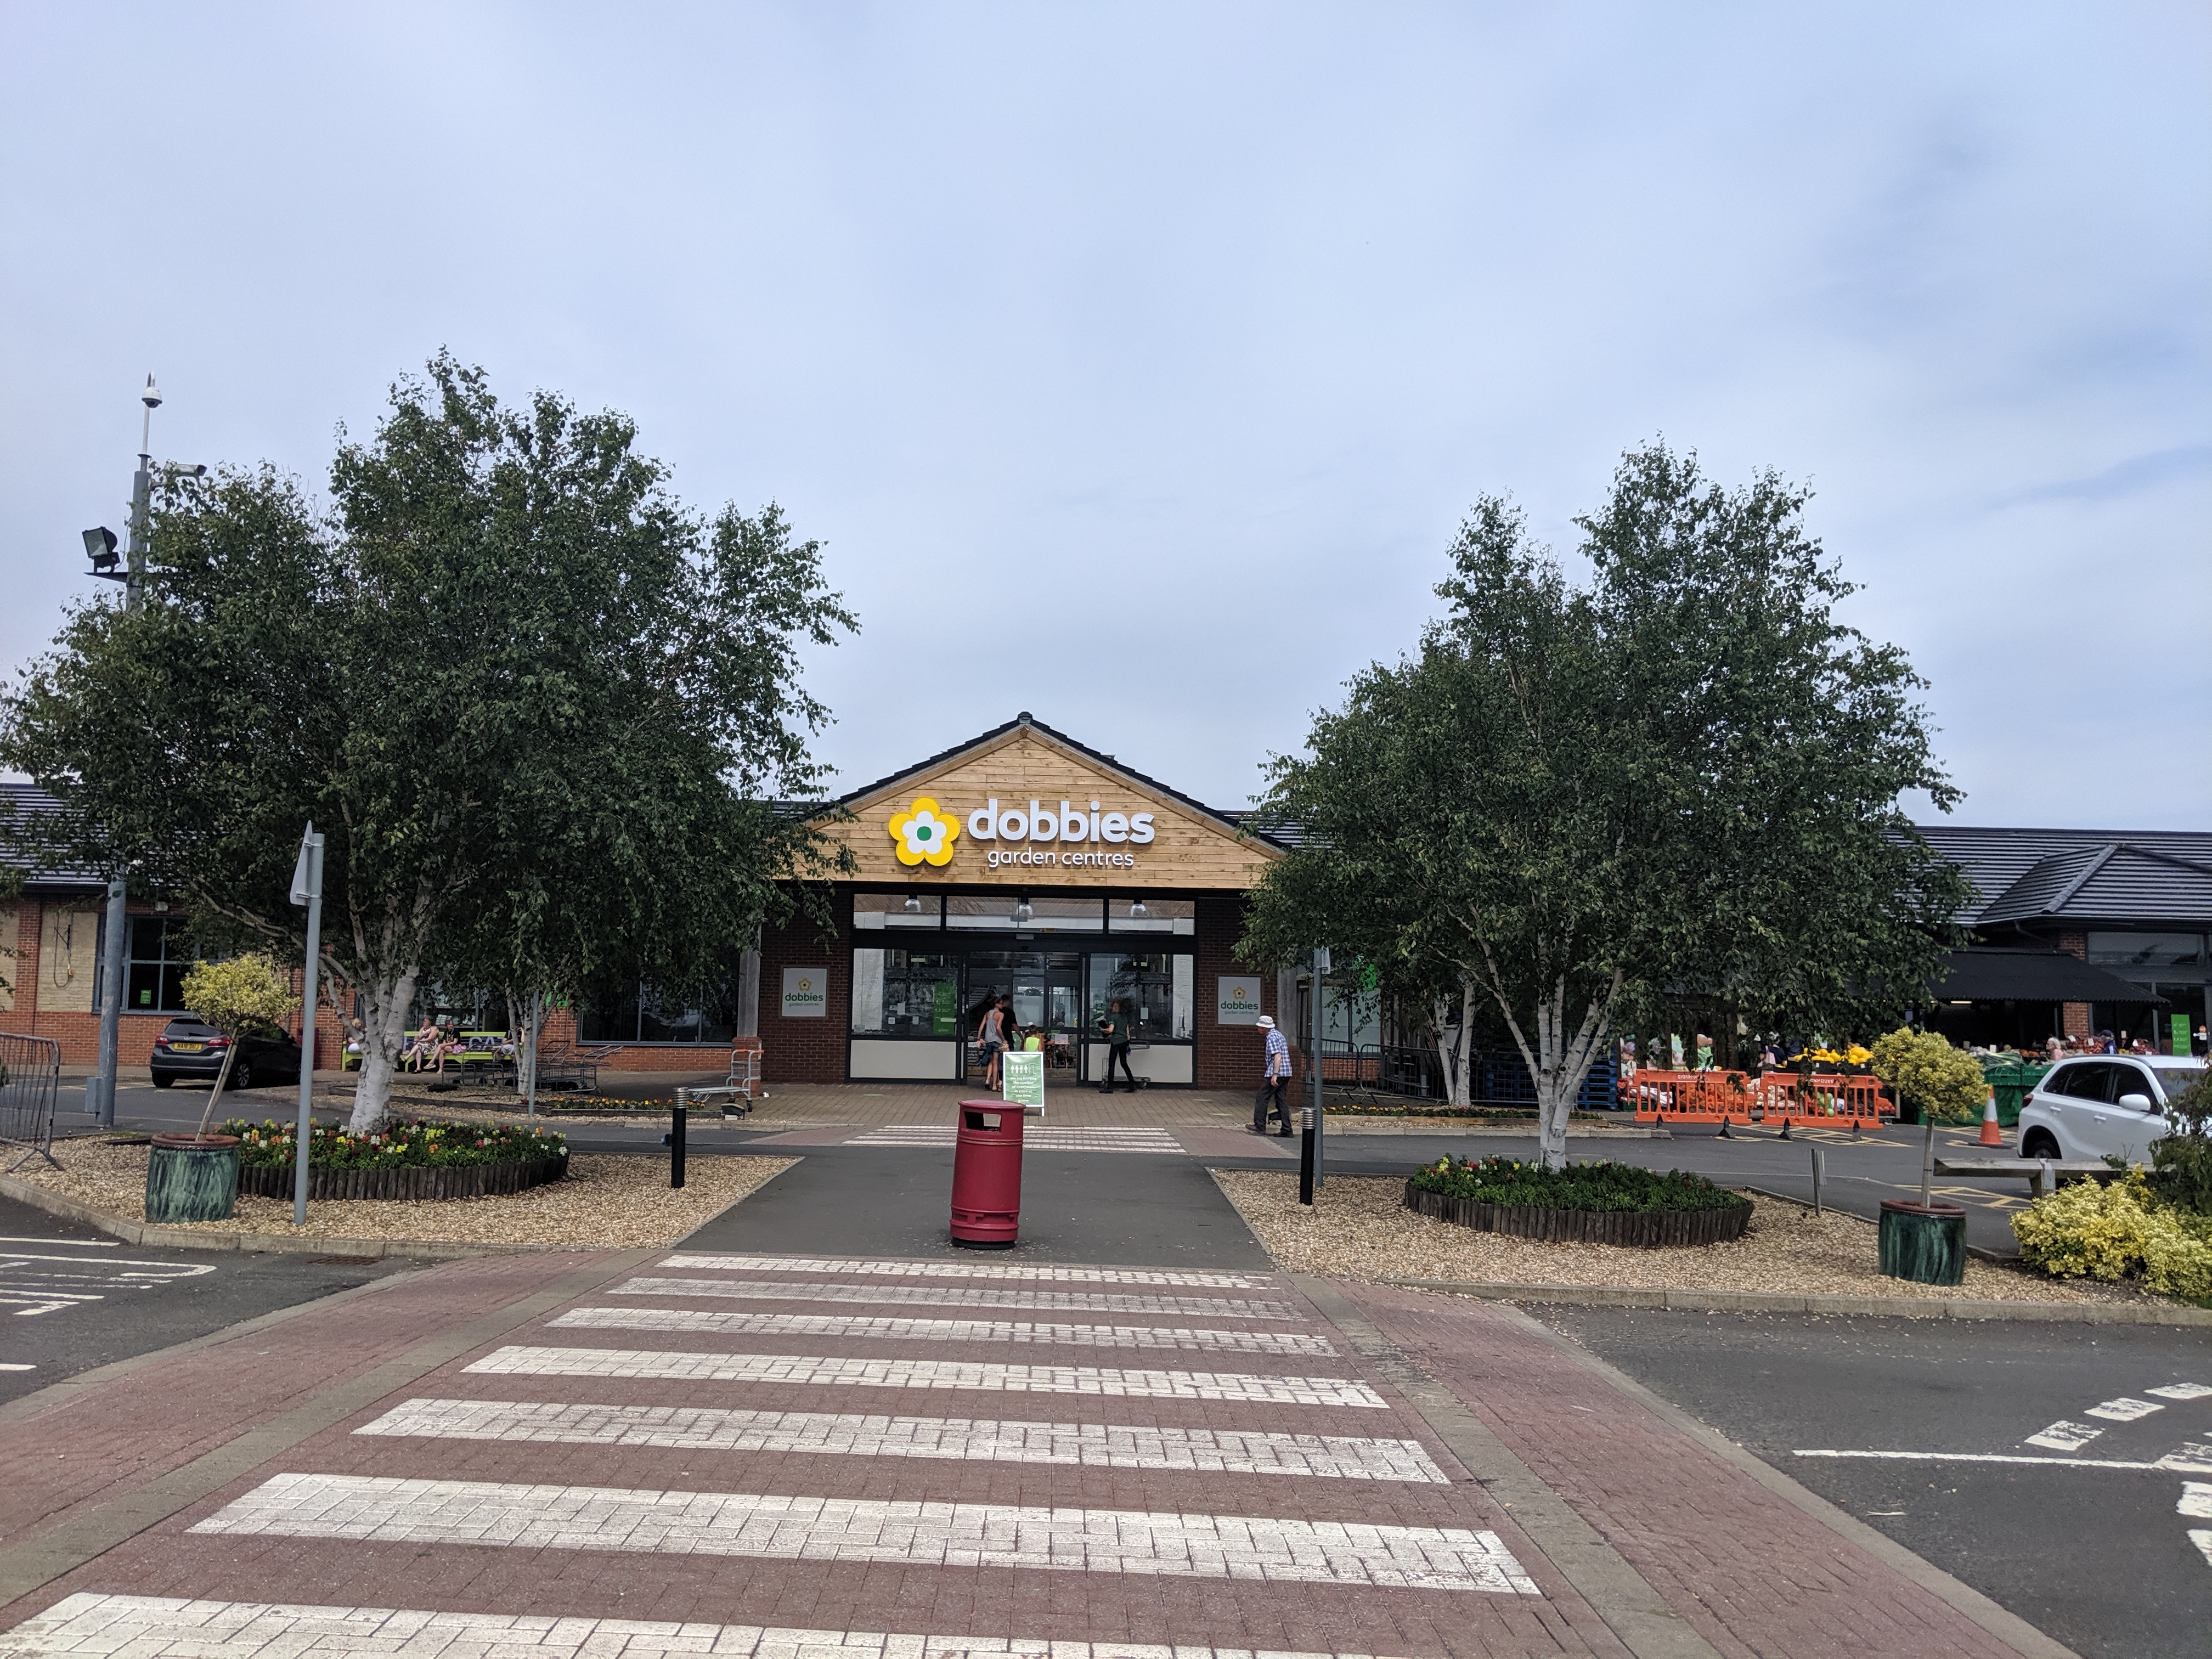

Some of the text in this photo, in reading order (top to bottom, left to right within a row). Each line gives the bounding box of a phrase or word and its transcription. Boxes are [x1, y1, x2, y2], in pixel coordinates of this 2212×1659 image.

[968, 799, 1155, 843] dobbies
[988, 847, 1134, 867] garden centres
[785, 992, 823, 1001] dobbies
[1221, 1001, 1259, 1010] dobbies
